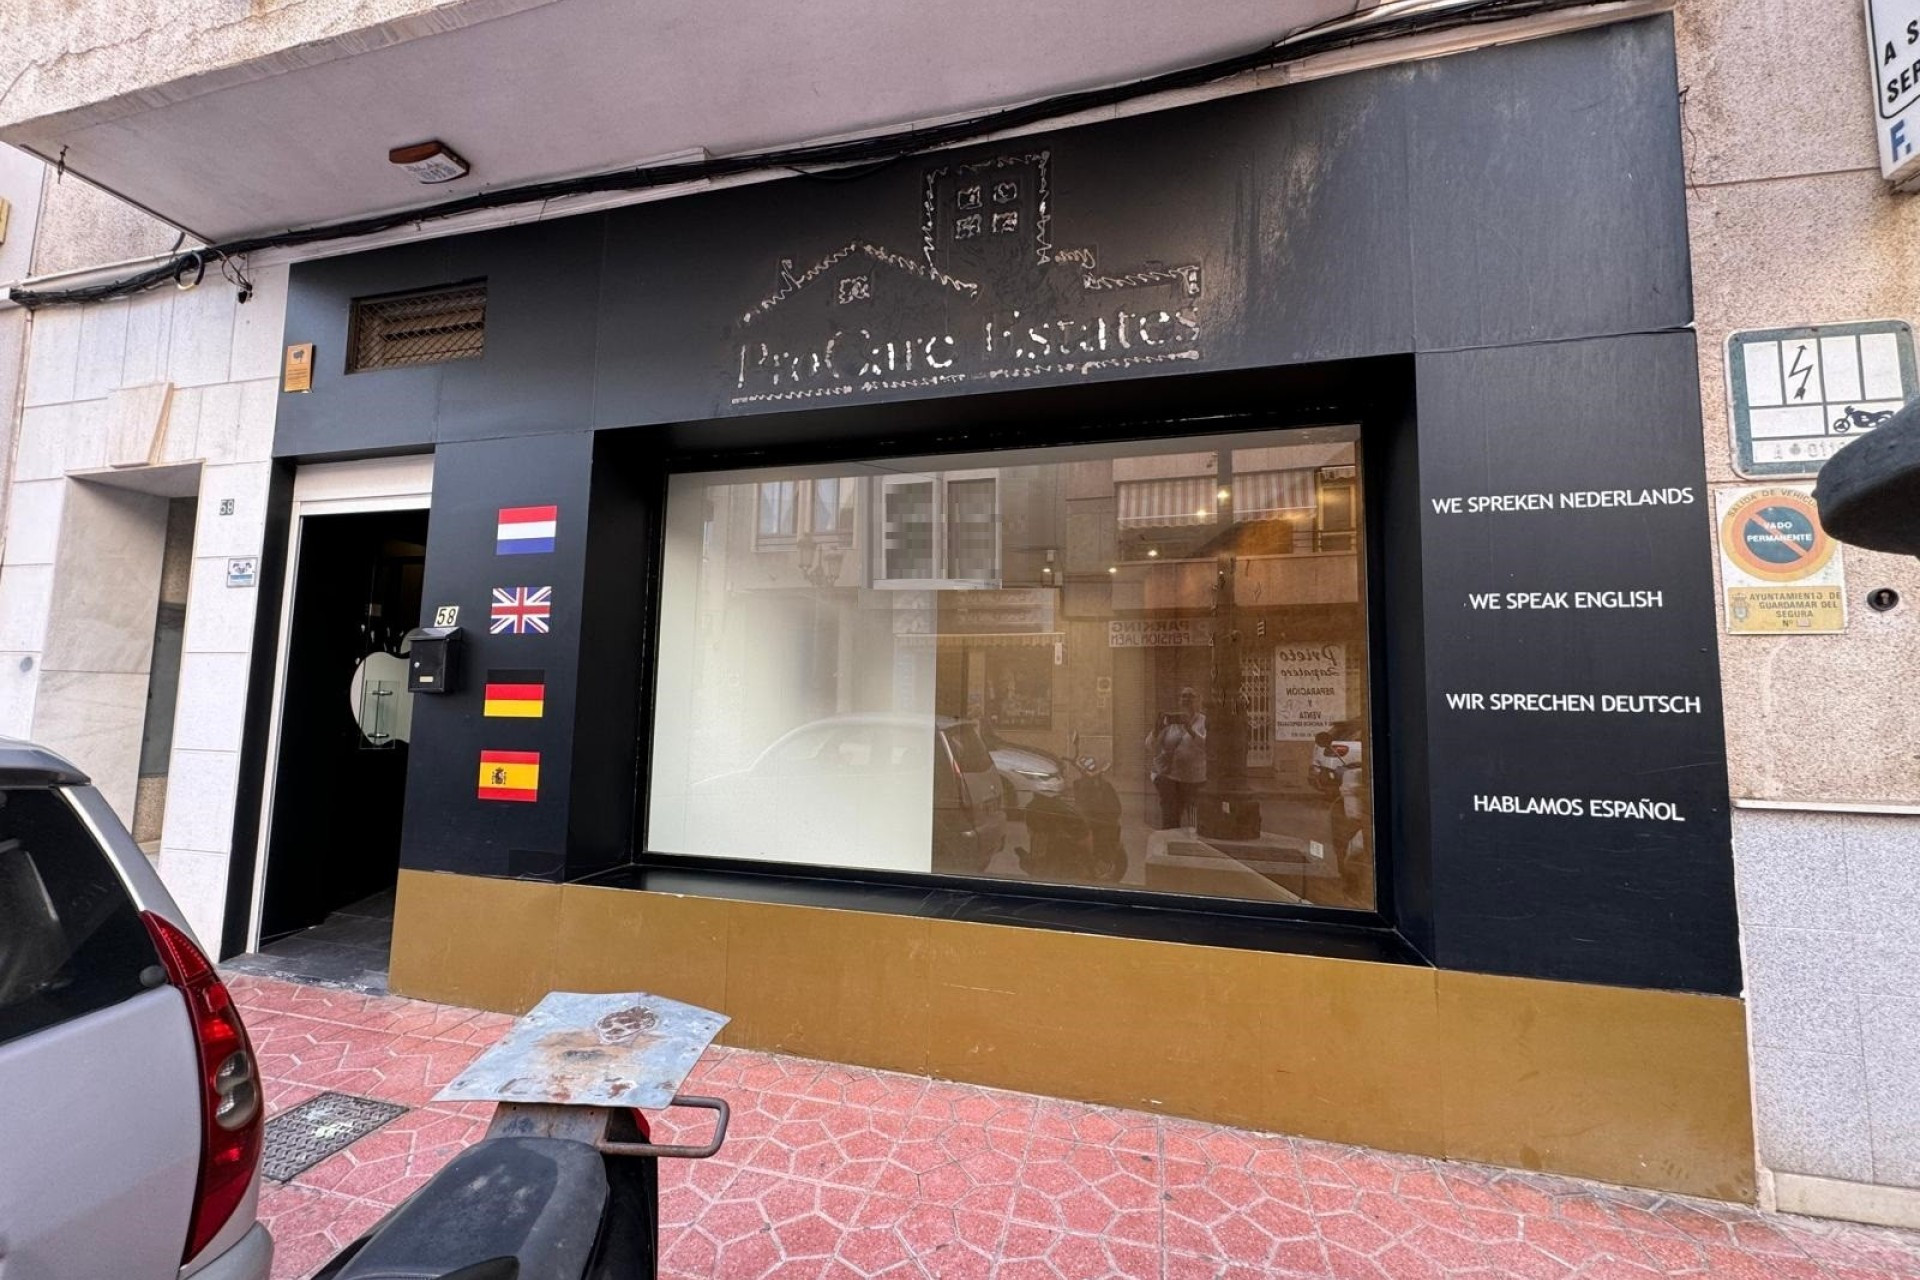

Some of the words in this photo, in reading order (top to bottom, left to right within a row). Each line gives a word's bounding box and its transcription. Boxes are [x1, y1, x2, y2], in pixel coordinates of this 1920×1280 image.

[1884, 41, 1897, 66] A
[220, 500, 234, 515] 58
[1432, 497, 1463, 514] WE
[1468, 493, 1554, 513] SPREKEN
[1560, 487, 1694, 509] NEDERLANDS
[1727, 494, 1758, 517] SALIDA
[1761, 489, 1777, 497] DE
[1764, 521, 1793, 530] VADO
[1746, 533, 1812, 543] PERMANENTE
[1468, 592, 1501, 610] WE
[1506, 592, 1569, 609] SPEAK
[1574, 590, 1663, 609] ENGLISH
[1749, 592, 1823, 601] AYUNTAMIENTO
[1829, 591, 1841, 600] DE
[1758, 601, 1818, 610] GUARDAMAR
[1821, 601, 1838, 609] DEL
[1775, 610, 1814, 618] SEGURA
[437, 608, 456, 625] 58
[1446, 693, 1485, 710] WIR
[1490, 693, 1595, 712] SPRECHEN
[1601, 695, 1701, 713] DEUTSCH
[1474, 795, 1584, 816] HABLAMOS
[1590, 798, 1685, 821] ESPAÑOL
